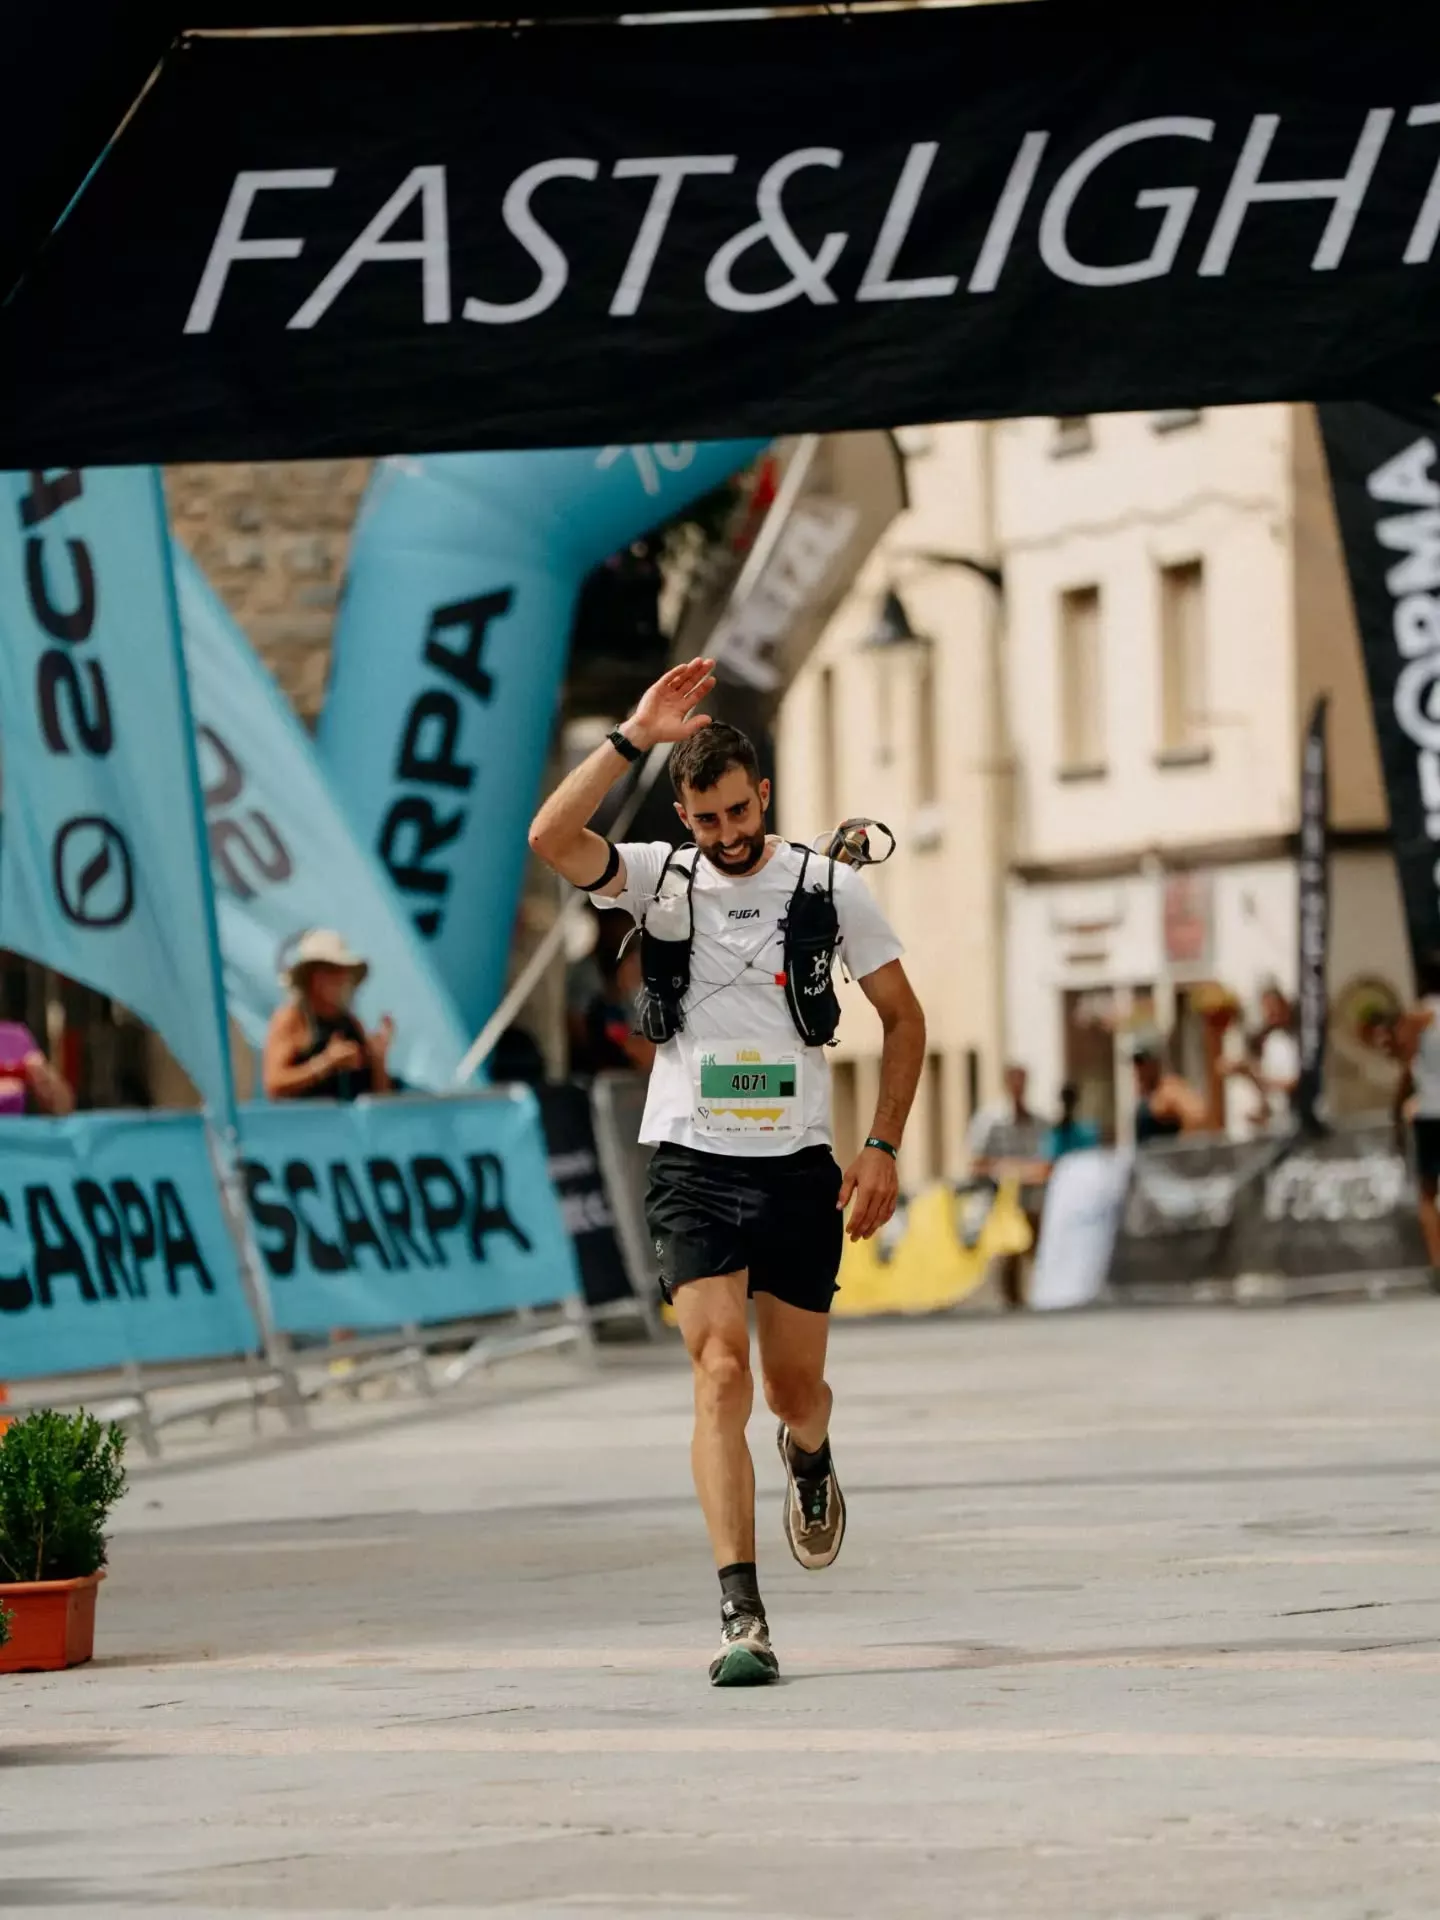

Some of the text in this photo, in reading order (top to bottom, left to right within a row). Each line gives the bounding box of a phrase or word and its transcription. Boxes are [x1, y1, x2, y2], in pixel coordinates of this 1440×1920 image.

[378, 584, 517, 940] RPA
[728, 909, 760, 919] FUGA
[731, 1074, 766, 1091] 4071
[240, 1152, 532, 1278] SCARPA
